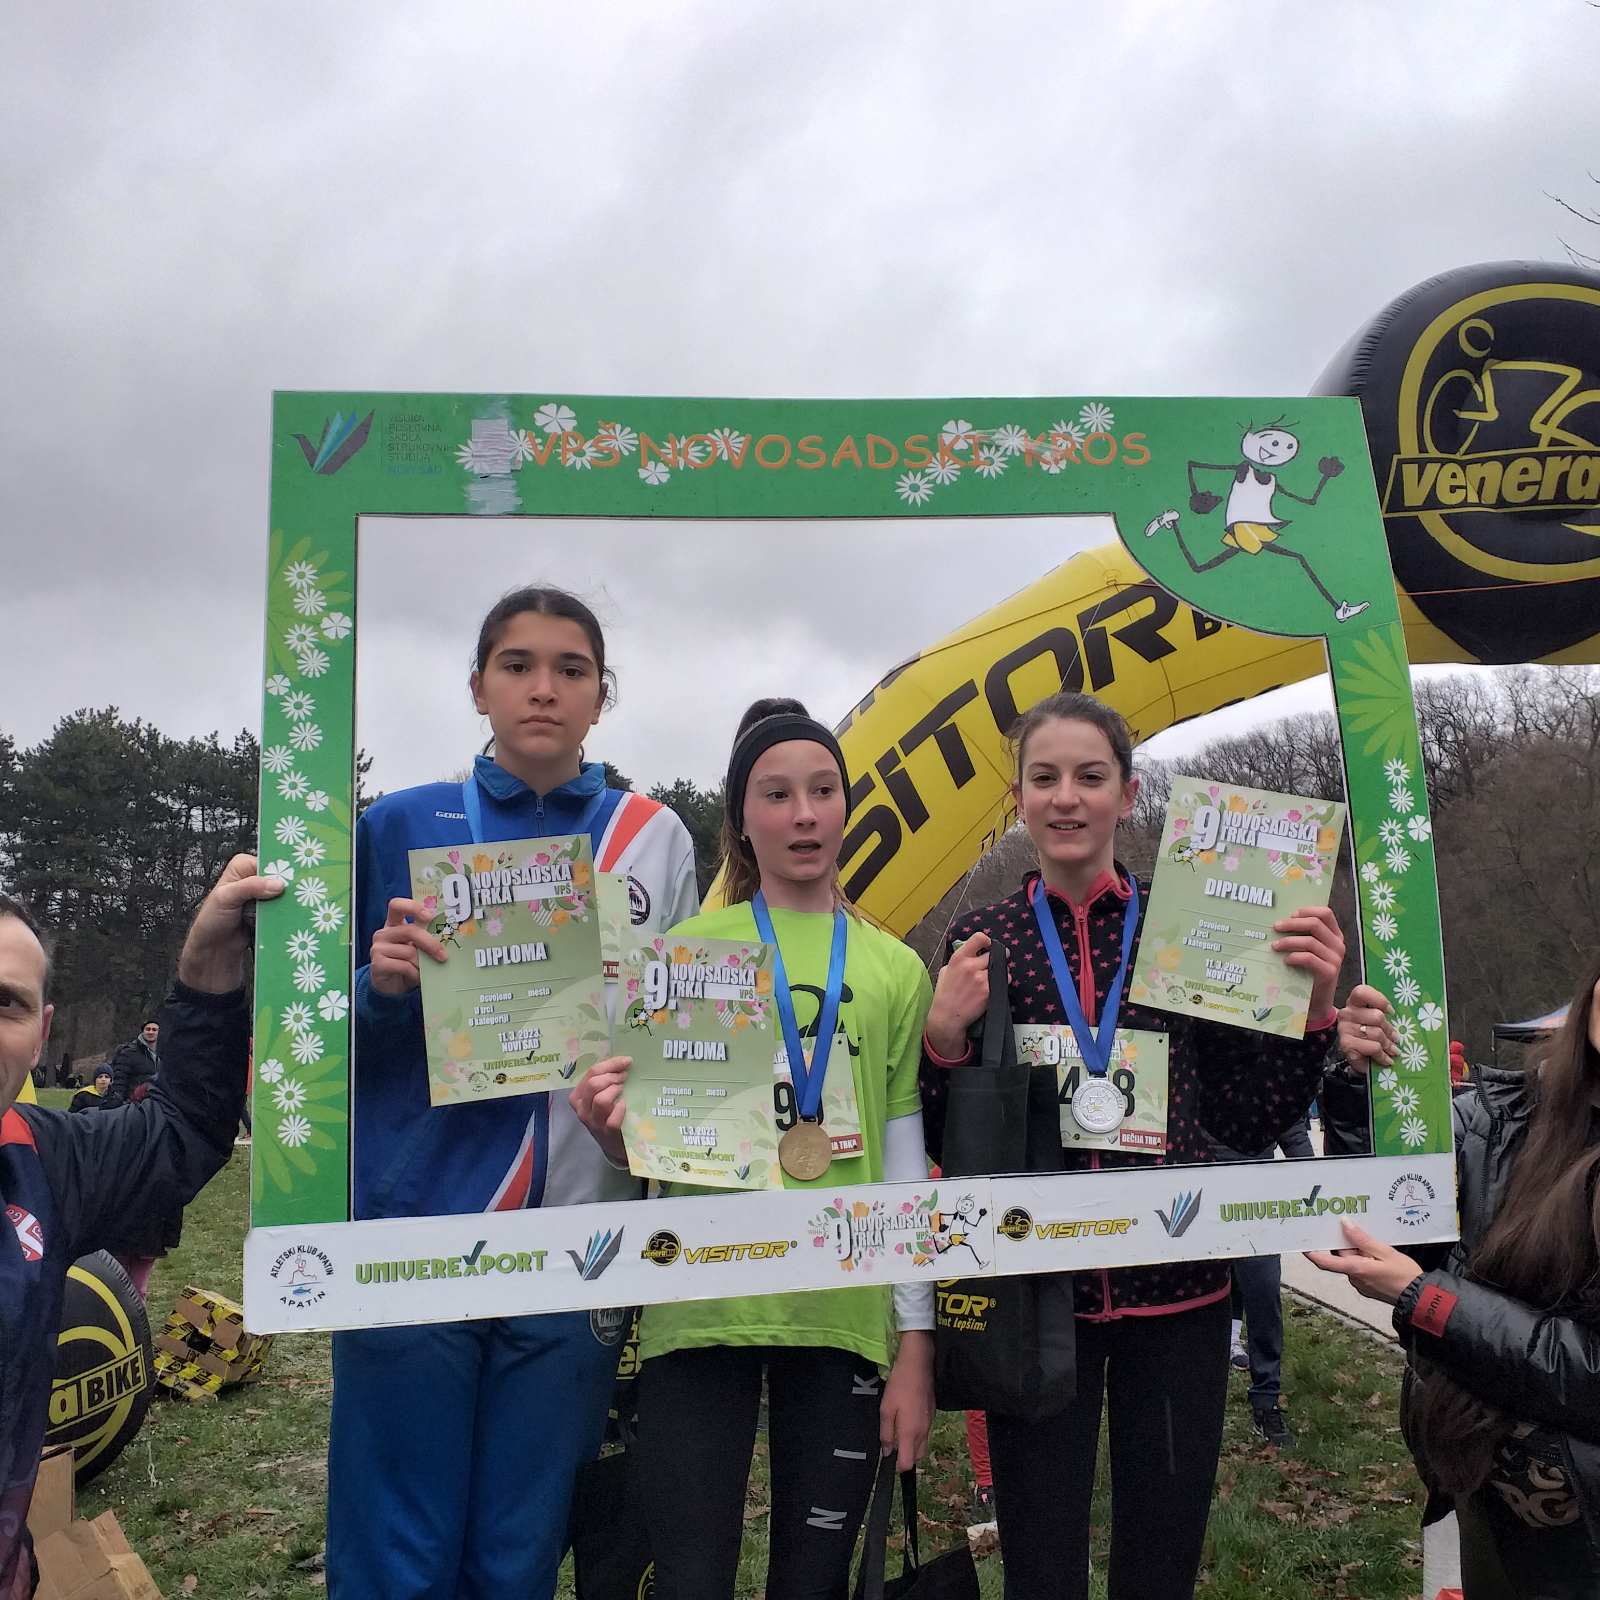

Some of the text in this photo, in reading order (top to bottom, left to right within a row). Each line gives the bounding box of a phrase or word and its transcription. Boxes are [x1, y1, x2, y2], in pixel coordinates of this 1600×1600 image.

[639, 430, 991, 470] NOVOSADSKI
[1023, 431, 1151, 467] KROS
[1220, 825, 1257, 847] TRKA
[1221, 810, 1318, 842] NOVOSADSKA
[471, 863, 572, 890] NOVOSADSKA
[471, 885, 513, 906] TRKA
[1204, 878, 1273, 907] DIPLOMA
[475, 942, 548, 968] DIPLOMA
[670, 963, 756, 986] NOVOSADSKA
[670, 980, 704, 998] TRKA
[663, 1040, 727, 1060] DIPLOMA
[1145, 1135, 1162, 1147] TRKA
[1388, 1174, 1407, 1201] ATLETSKI
[1407, 1173, 1422, 1182] KLUB
[1220, 1185, 1370, 1222] UNIVEREXPORT
[852, 1213, 931, 1232] NOVOSADSKA
[1034, 1218, 1131, 1240] VISITOR
[1396, 1212, 1430, 1225] APATIN
[270, 1245, 334, 1279] ATLETSKI KLUB APATIN
[355, 1240, 548, 1284] UNIVEREXPORT
[684, 1240, 790, 1264] VISITOR
[280, 1291, 326, 1308] APATIN
[806, 1373, 881, 1530] NIK
